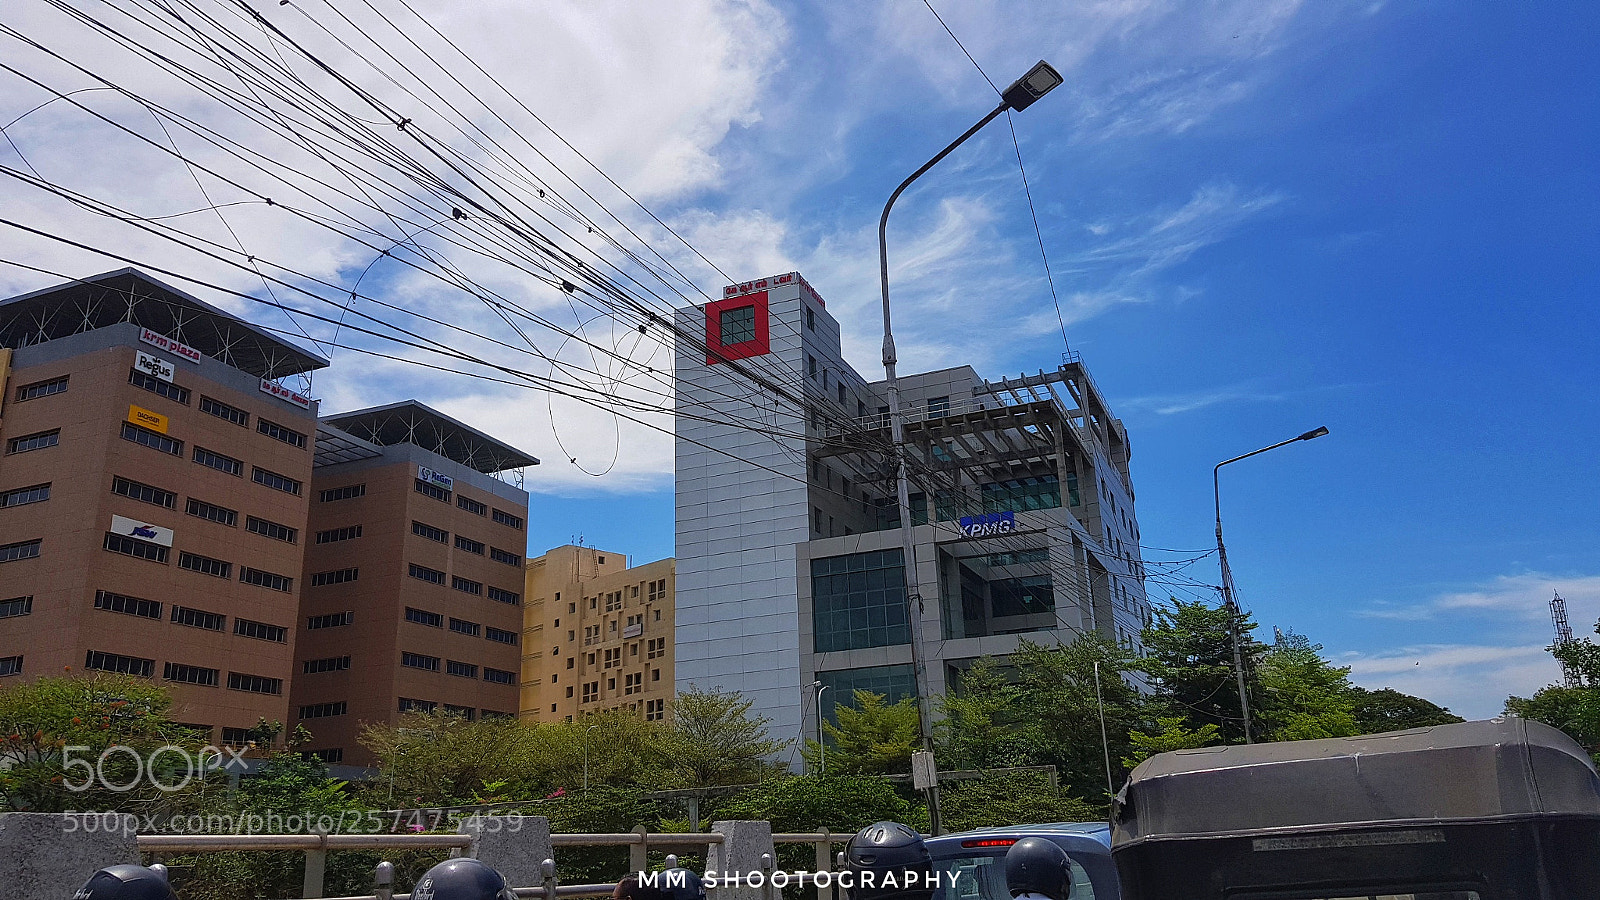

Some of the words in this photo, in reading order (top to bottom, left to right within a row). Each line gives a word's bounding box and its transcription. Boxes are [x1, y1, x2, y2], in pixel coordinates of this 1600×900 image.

[143, 329, 168, 347] krm
[169, 341, 200, 360] plaza
[139, 355, 171, 377] Regus
[959, 519, 1011, 539] KPMG
